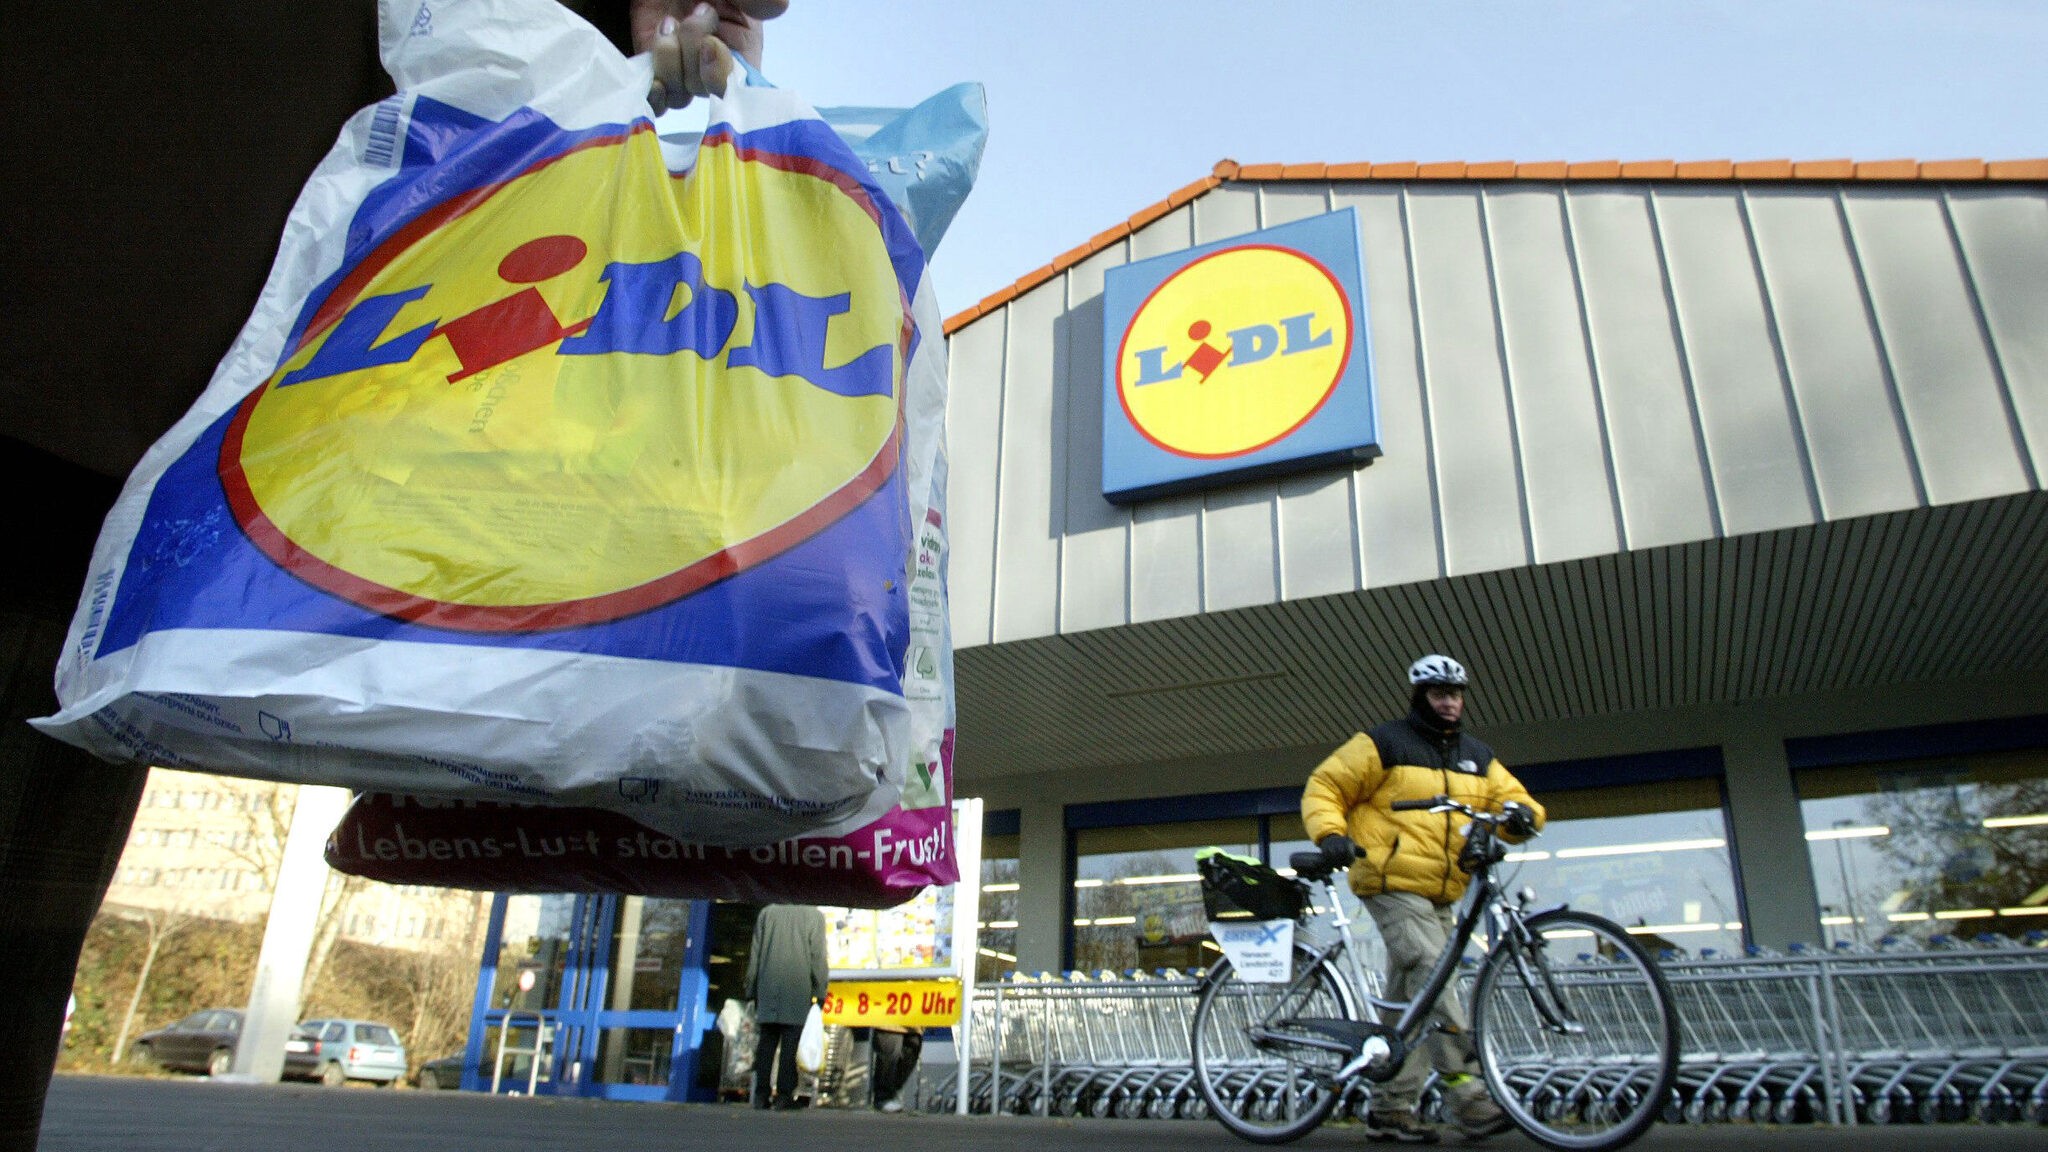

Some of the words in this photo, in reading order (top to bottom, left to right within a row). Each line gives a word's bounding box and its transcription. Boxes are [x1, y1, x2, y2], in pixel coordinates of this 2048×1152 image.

[723, 820, 947, 872] ollen-Frust!
[823, 992, 844, 1015] Sa
[921, 991, 957, 1015] Uhr
